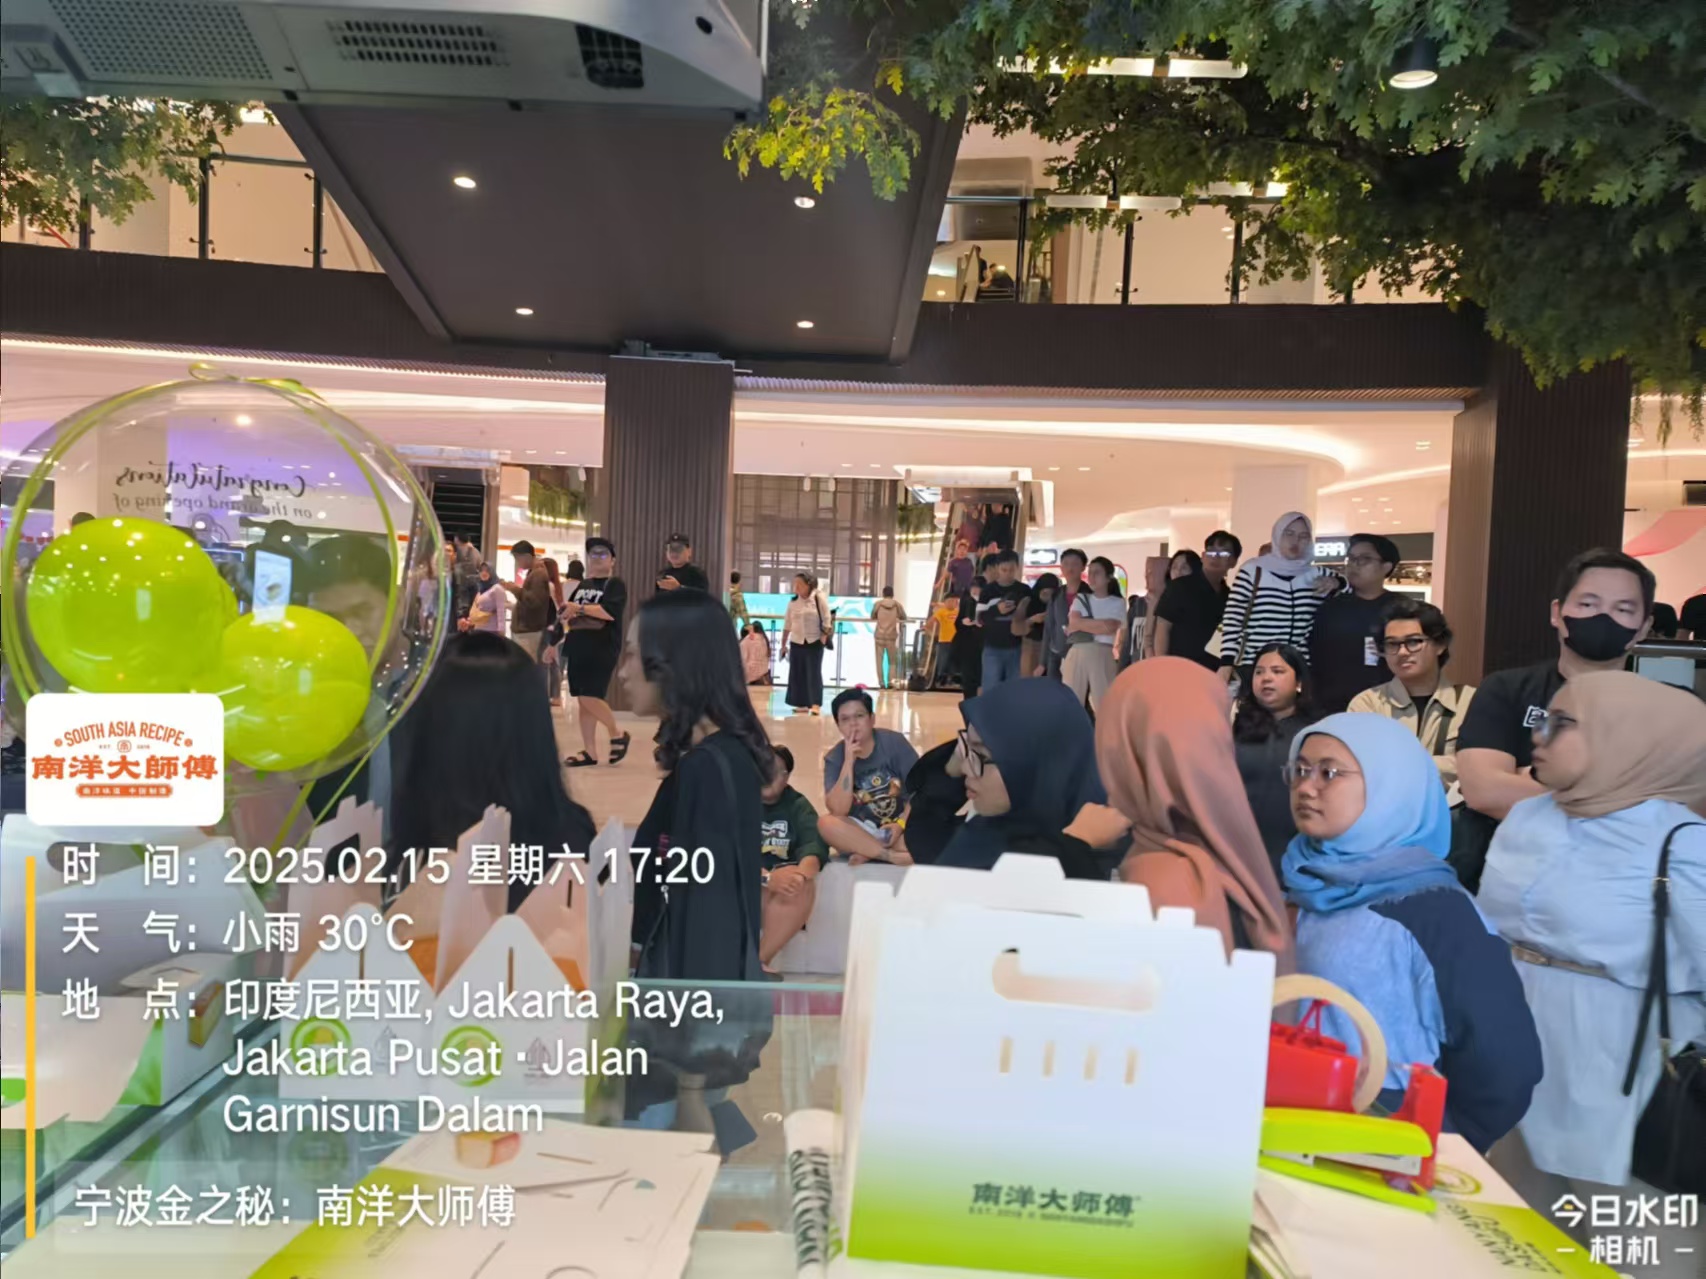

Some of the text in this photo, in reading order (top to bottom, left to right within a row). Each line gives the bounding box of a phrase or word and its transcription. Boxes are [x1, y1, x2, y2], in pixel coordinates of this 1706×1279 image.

[973, 1182, 1135, 1217] 南洋大师傅
